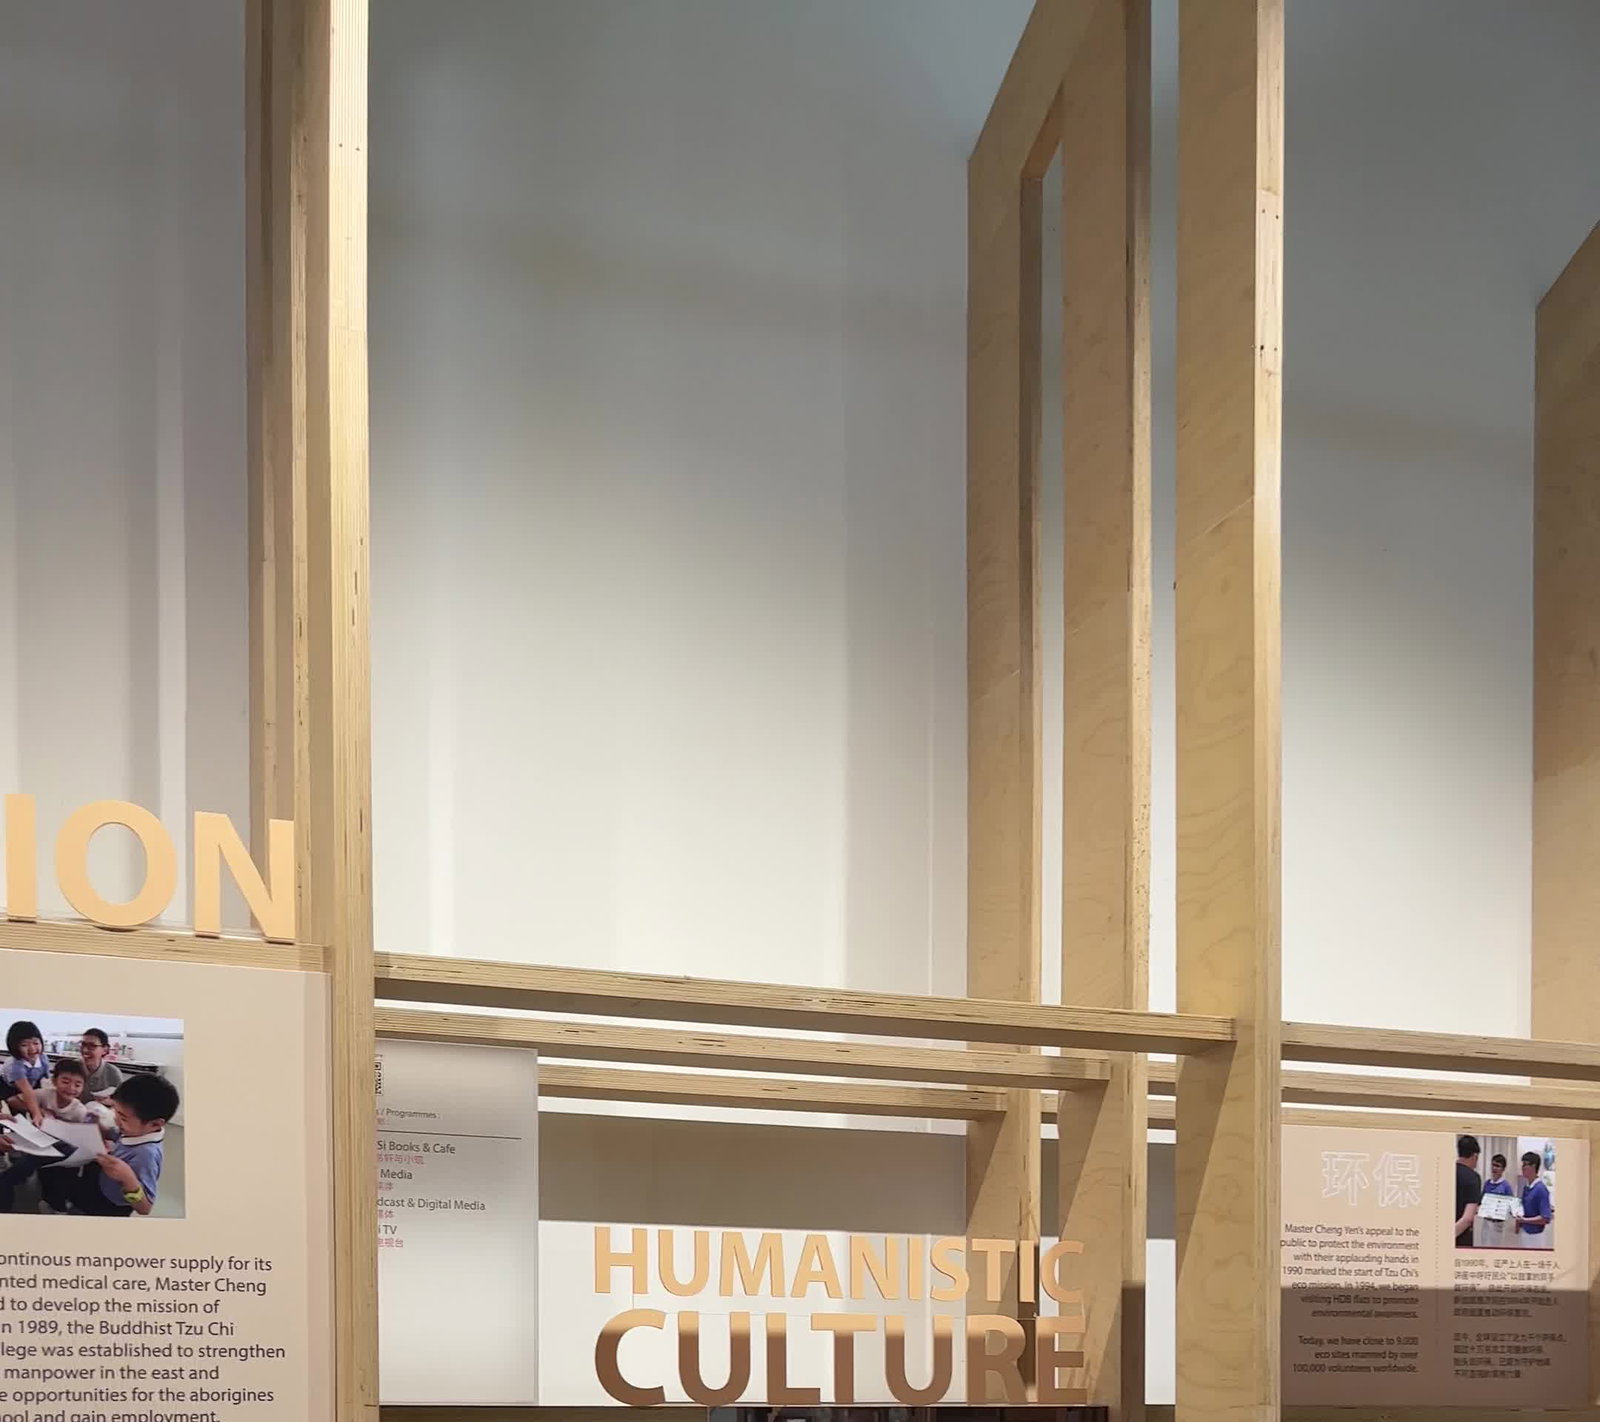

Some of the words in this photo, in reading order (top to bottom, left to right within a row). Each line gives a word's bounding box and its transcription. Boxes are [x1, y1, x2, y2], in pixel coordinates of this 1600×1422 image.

[389, 1141, 420, 1152] Books
[422, 1143, 430, 1153] &
[433, 1144, 456, 1154] Cafe
[380, 1169, 413, 1180] Media
[1321, 1151, 1421, 1208] 环保
[407, 1198, 416, 1208] &
[418, 1199, 451, 1211] Digital
[454, 1200, 486, 1211] Media
[383, 1225, 398, 1235] TV
[1285, 1224, 1314, 1235] Master
[1314, 1224, 1342, 1237] Cheng
[1365, 1226, 1394, 1238] appeal
[1395, 1227, 1404, 1236] to
[1405, 1227, 1419, 1237] the
[1280, 1238, 1306, 1248] public
[1308, 1239, 1317, 1248] to
[1319, 1239, 1349, 1250] protect
[1351, 1240, 1365, 1249] the
[1366, 1241, 1420, 1250] environment
[76, 1255, 165, 1270] manpower
[170, 1256, 224, 1274] supply
[228, 1256, 249, 1271] for
[254, 1258, 272, 1271] its
[594, 1226, 1085, 1304] HUMANISTIC
[1293, 1253, 1312, 1262] with
[1314, 1253, 1334, 1262] their
[1336, 1253, 1382, 1265] applauding
[1384, 1254, 1410, 1264] hands
[1411, 1255, 1419, 1264] in
[1283, 1266, 1303, 1275] 1990
[1304, 1266, 1336, 1276] marked
[1338, 1267, 1352, 1276] the
[1354, 1267, 1373, 1276] start
[1374, 1267, 1383, 1277] of
[1383, 1268, 1399, 1277] Tzu
[42, 1275, 108, 1290] medical
[112, 1279, 151, 1292] care,
[155, 1277, 210, 1292] Master
[214, 1278, 267, 1296] Cheng
[1292, 1282, 1307, 1291] eco
[1393, 1282, 1419, 1293] began
[10, 1299, 28, 1312] to
[32, 1297, 100, 1316] develop
[104, 1299, 132, 1313] the
[136, 1300, 198, 1314] mission
[202, 1299, 220, 1313] of
[19, 1320, 62, 1338] 1989,
[67, 1321, 95, 1335] the
[99, 1321, 172, 1336] Buddhist
[175, 1322, 204, 1336] Tzu
[207, 1322, 234, 1336] Chi
[1386, 1337, 1395, 1346] to
[41, 1346, 74, 1358] was
[78, 1343, 172, 1359] established
[177, 1346, 194, 1358] to
[198, 1344, 286, 1361] strengthen
[594, 1309, 1088, 1406] CULTURE
[1314, 1351, 1330, 1360] eco
[1388, 1351, 1398, 1361] by
[4, 1368, 95, 1384] manpower
[100, 1366, 115, 1380] in
[119, 1366, 147, 1380] the
[151, 1367, 185, 1380] east
[189, 1366, 220, 1380] and
[12, 1388, 127, 1405] opportunities
[132, 1387, 154, 1402] for
[158, 1388, 186, 1402] the
[190, 1388, 274, 1405] aborigines
